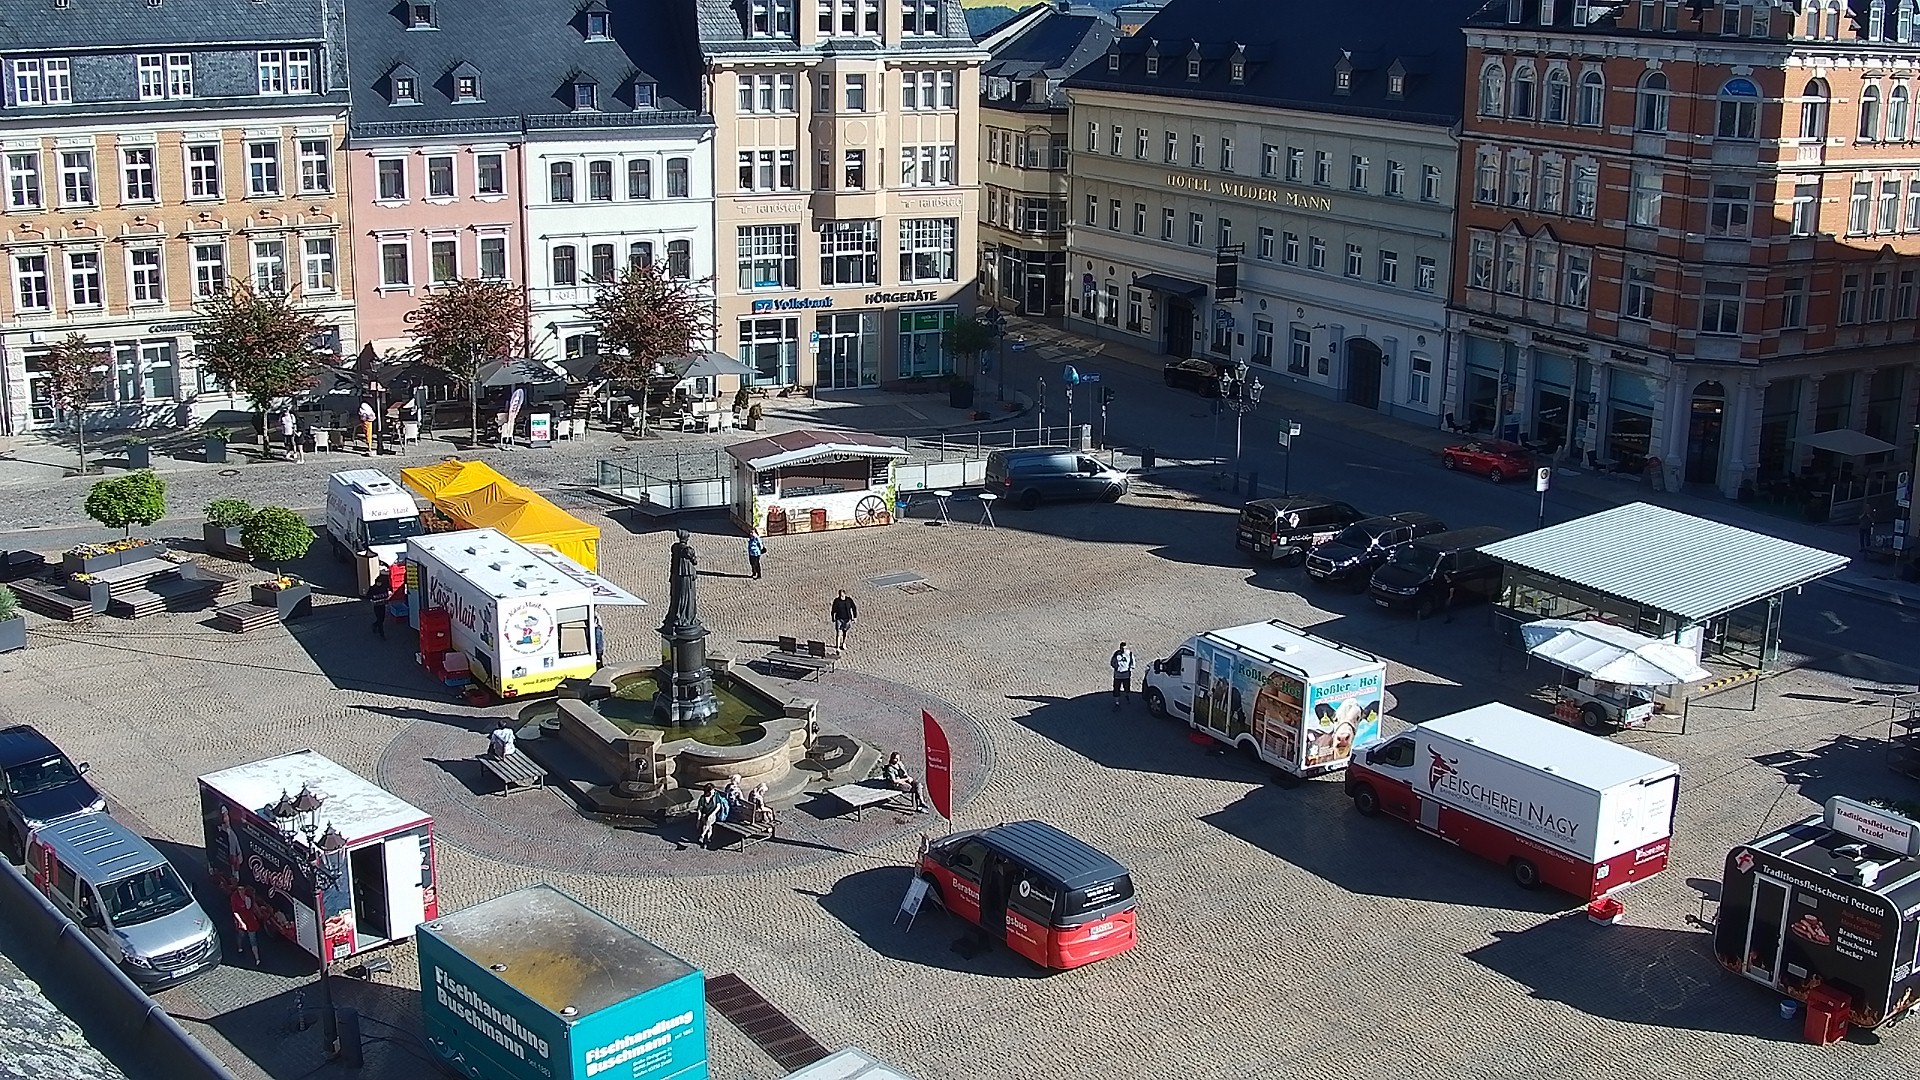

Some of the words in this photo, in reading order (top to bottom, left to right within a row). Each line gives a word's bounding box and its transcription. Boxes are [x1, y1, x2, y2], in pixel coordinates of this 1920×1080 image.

[919, 196, 963, 208] randstad
[1167, 174, 1211, 192] HOTEL
[1220, 182, 1277, 203] WILDER
[1286, 192, 1331, 211] MANN
[756, 201, 802, 214] randstad
[775, 296, 833, 310] Volksbank
[865, 290, 938, 305] HÖRGERÄTE
[1359, 675, 1378, 688] Hof
[1431, 766, 1523, 817] FLEISCHEREI
[1837, 807, 1908, 839] Traditionsfleischerei
[1857, 824, 1884, 840] Petzold
[1762, 864, 1849, 904] Traditionsfleischerei
[1851, 897, 1885, 917] Petzold
[1837, 936, 1878, 957] Rauchwurst
[1838, 927, 1873, 946] Bratwurst
[434, 965, 549, 1059] Fischhandlung
[436, 986, 525, 1060] Buschmann
[585, 1009, 694, 1064] Fischhandlung
[586, 1032, 672, 1078] Buschmann
